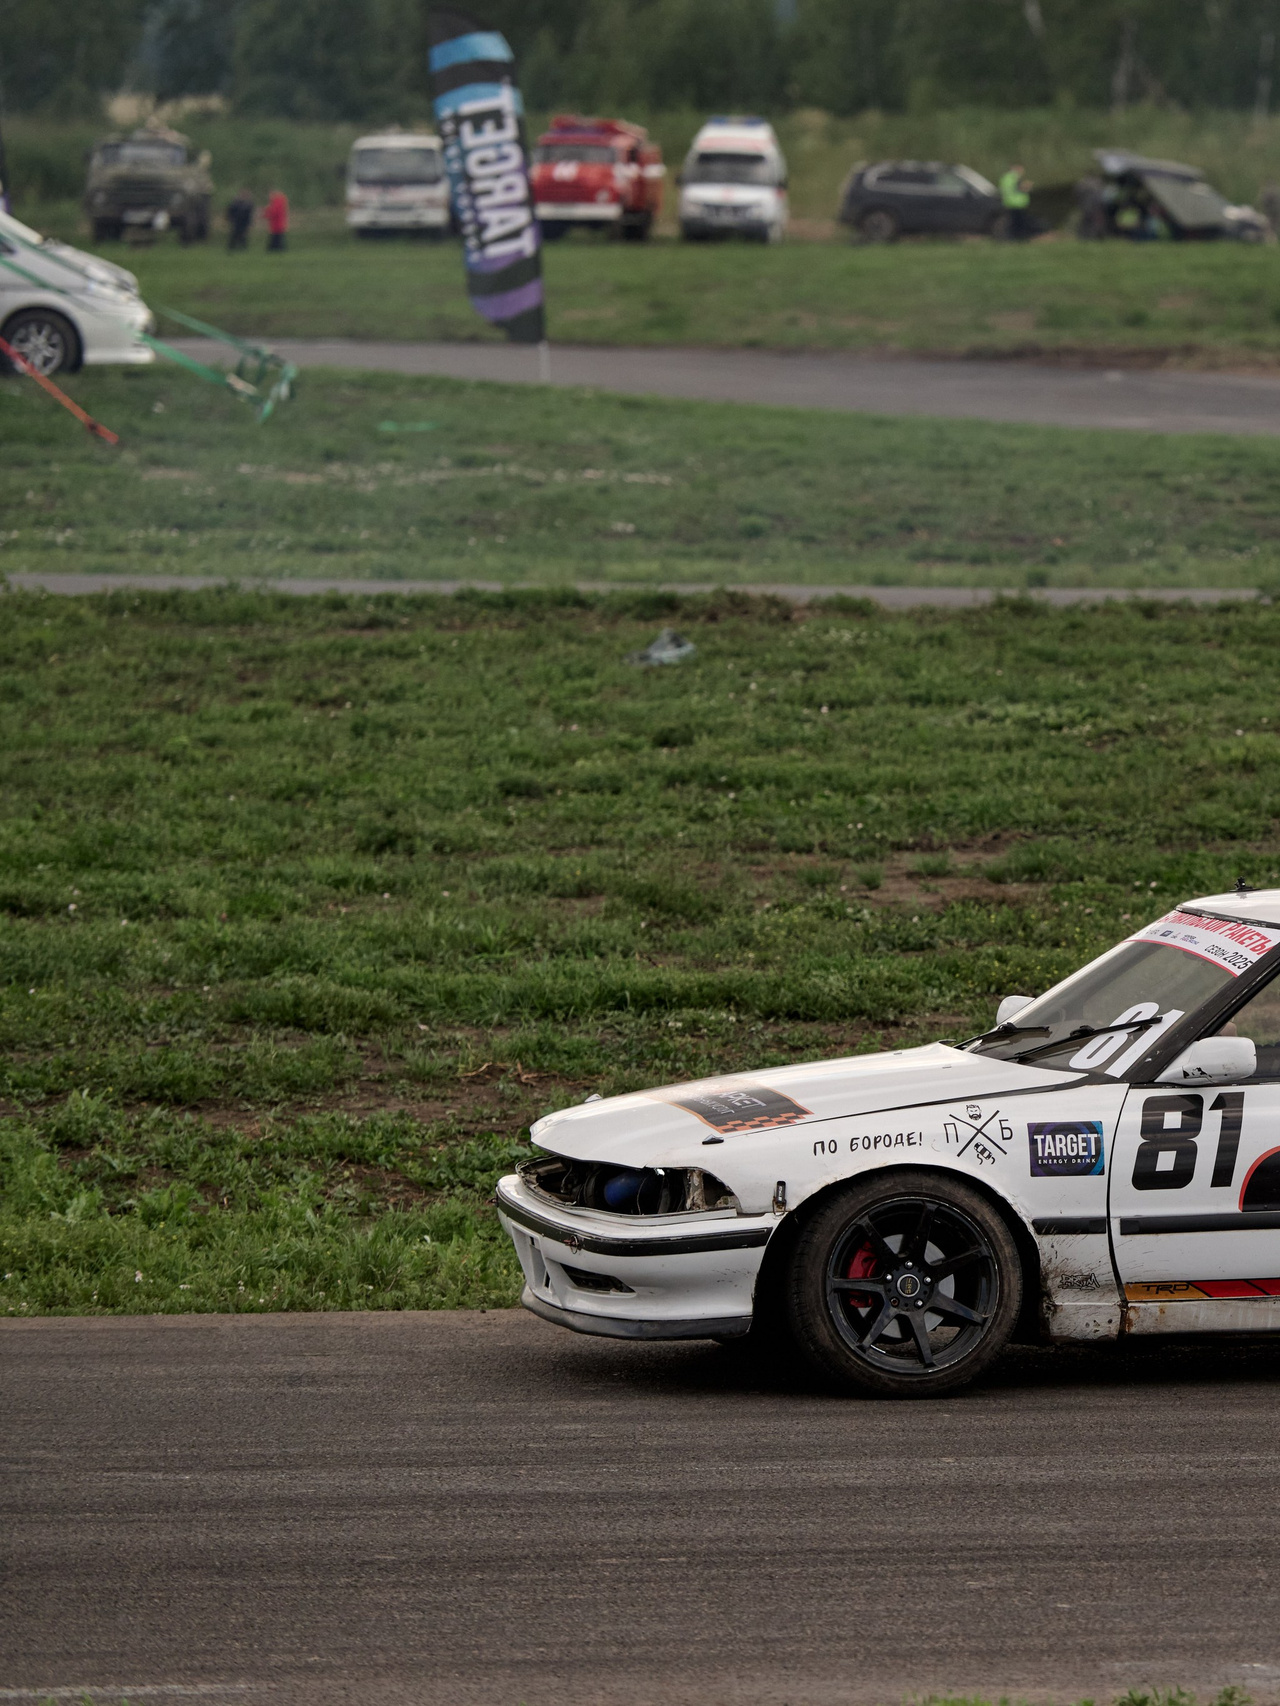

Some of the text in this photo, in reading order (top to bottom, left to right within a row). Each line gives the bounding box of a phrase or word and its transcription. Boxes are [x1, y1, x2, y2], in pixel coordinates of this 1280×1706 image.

[1223, 951, 1253, 970] 2025
[813, 1131, 923, 1157] ПО БОРОДЕ!
[1033, 1133, 1100, 1158] TARGET
[1131, 1091, 1246, 1191] 81
[1071, 1157, 1097, 1165] DRINK
[1142, 1283, 1190, 1295] TRD
